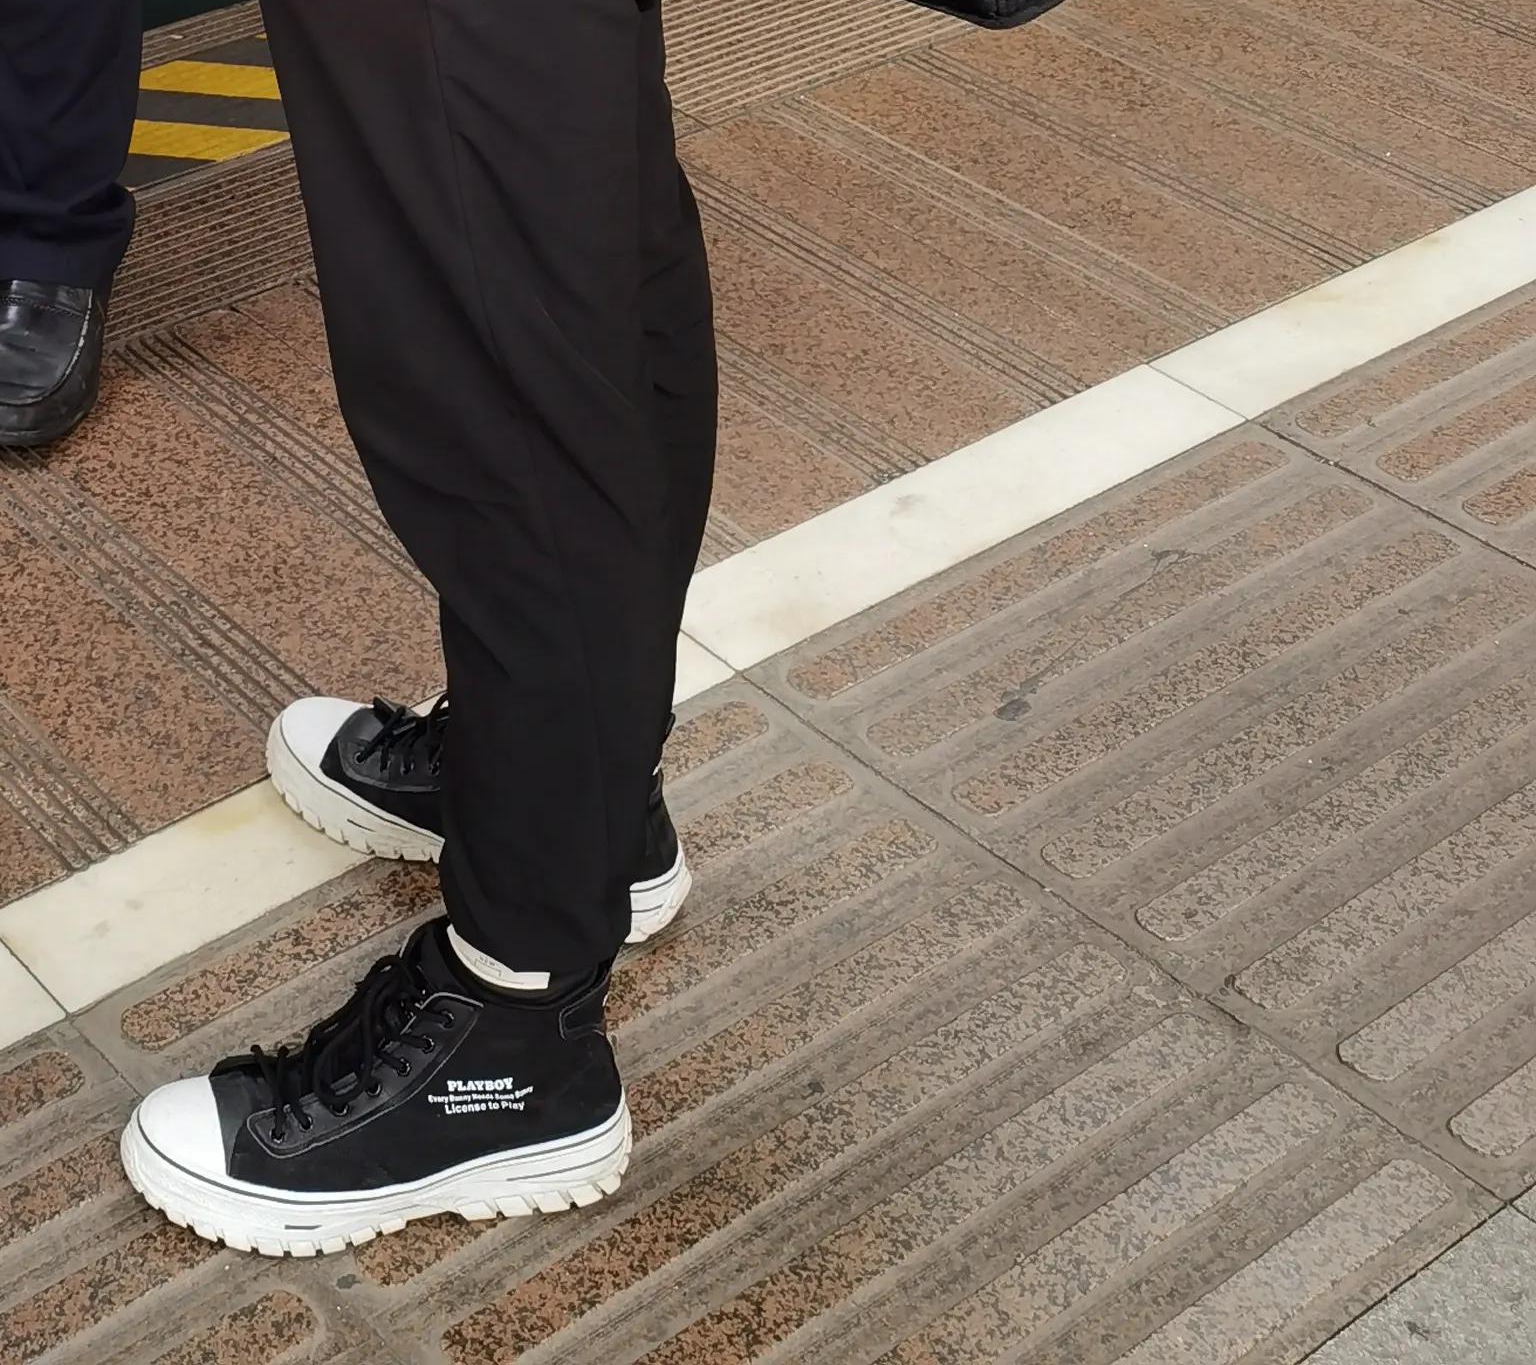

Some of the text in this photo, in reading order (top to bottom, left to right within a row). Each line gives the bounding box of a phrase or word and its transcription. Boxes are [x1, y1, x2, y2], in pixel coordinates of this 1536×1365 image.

[447, 1077, 514, 1092] PLAYBOY
[444, 1100, 525, 1115] License to Play
